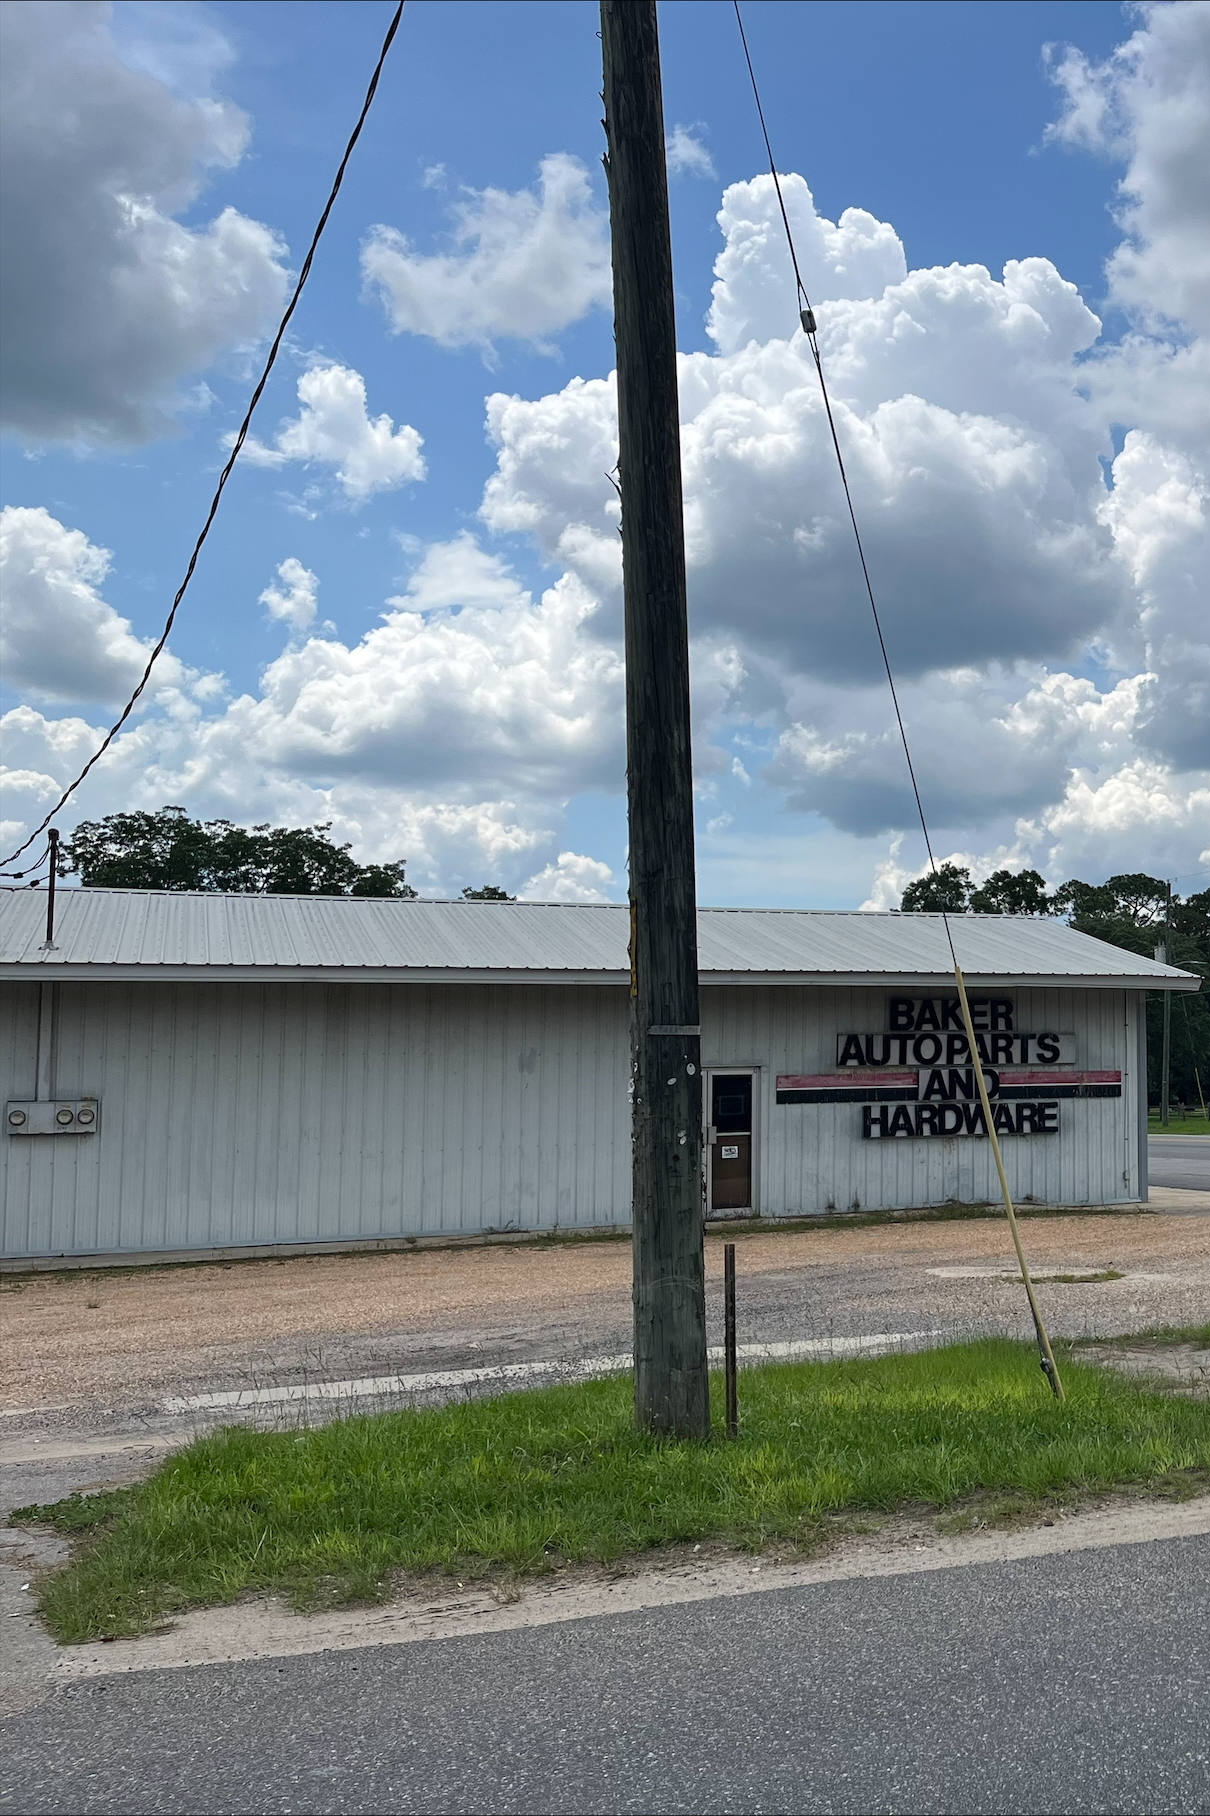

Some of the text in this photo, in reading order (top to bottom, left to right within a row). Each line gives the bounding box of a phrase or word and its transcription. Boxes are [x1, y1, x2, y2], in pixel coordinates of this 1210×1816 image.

[890, 999, 1014, 1031] BAKER
[923, 1069, 1000, 1101] AND
[863, 1102, 1059, 1138] HARDWARE
